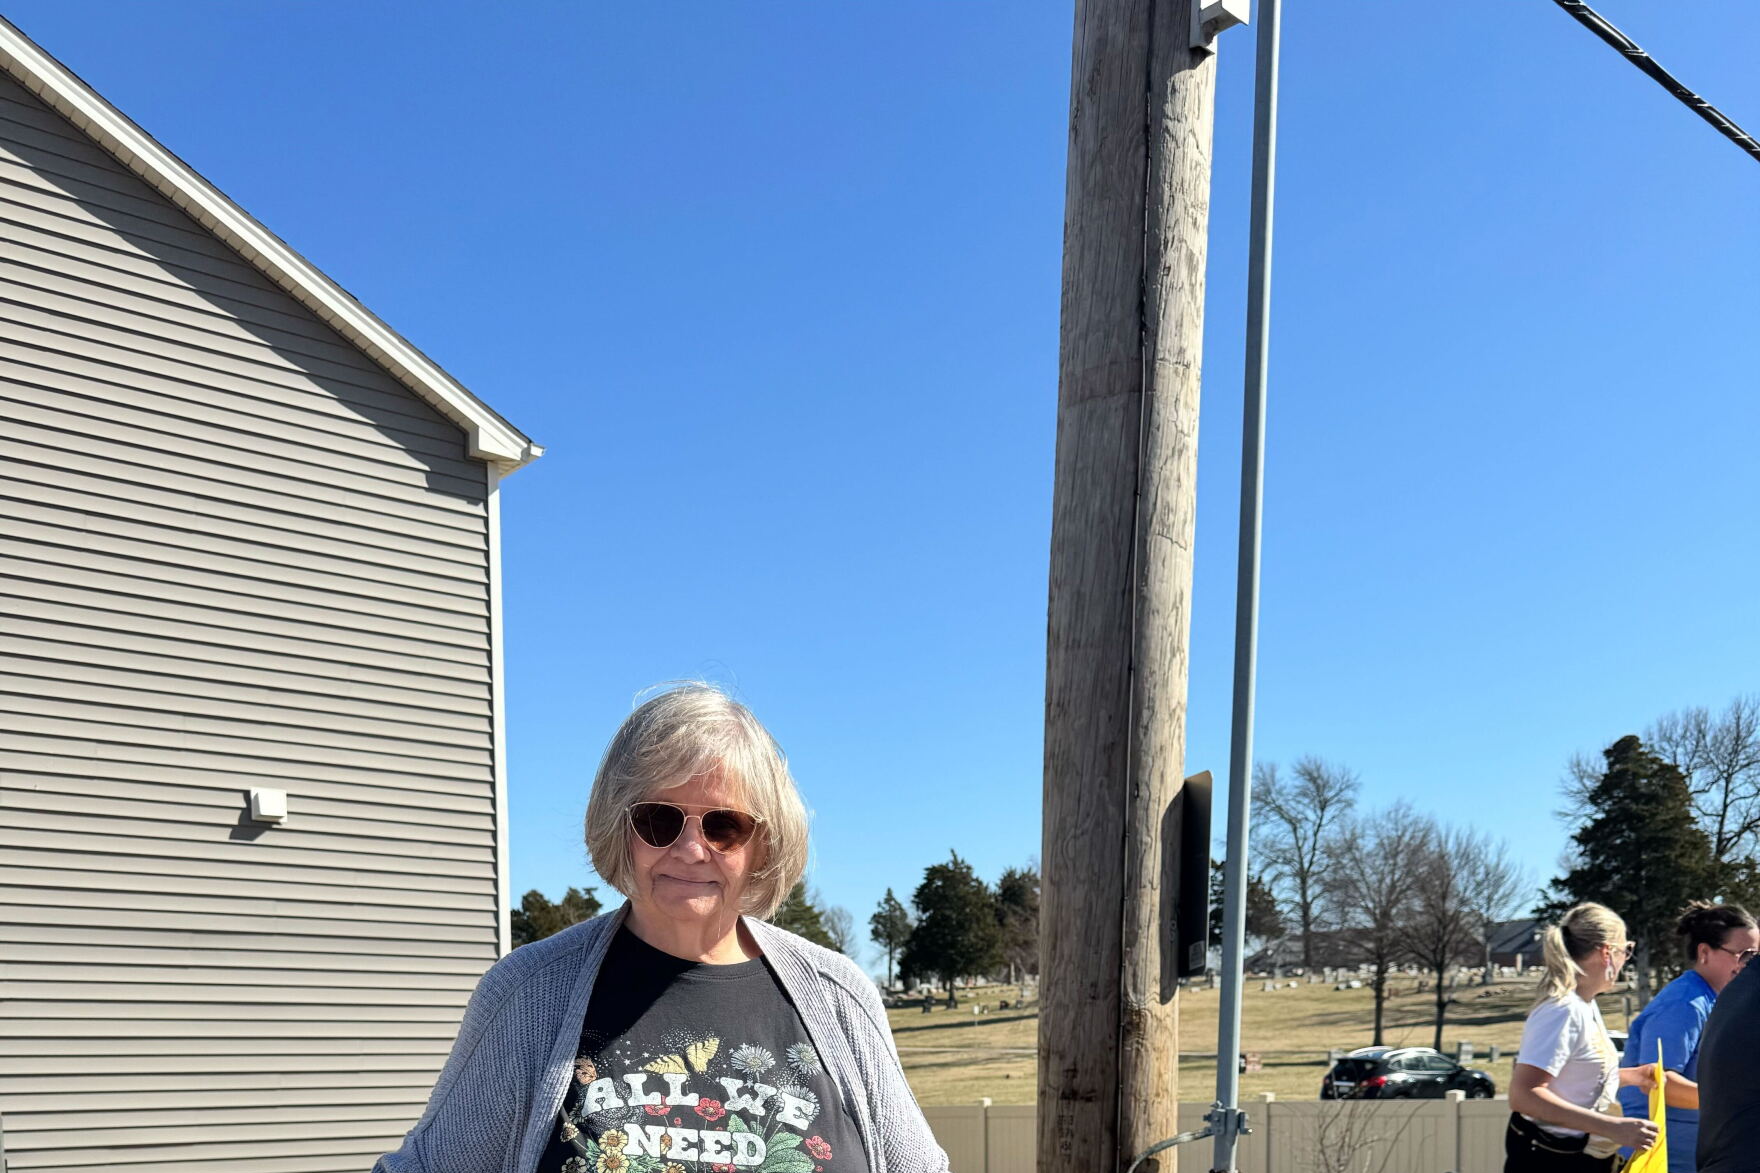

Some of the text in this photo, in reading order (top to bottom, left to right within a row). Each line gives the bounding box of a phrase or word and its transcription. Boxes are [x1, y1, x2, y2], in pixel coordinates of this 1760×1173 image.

[580, 1072, 817, 1131] ALL WE
[622, 1123, 767, 1166] NEED
